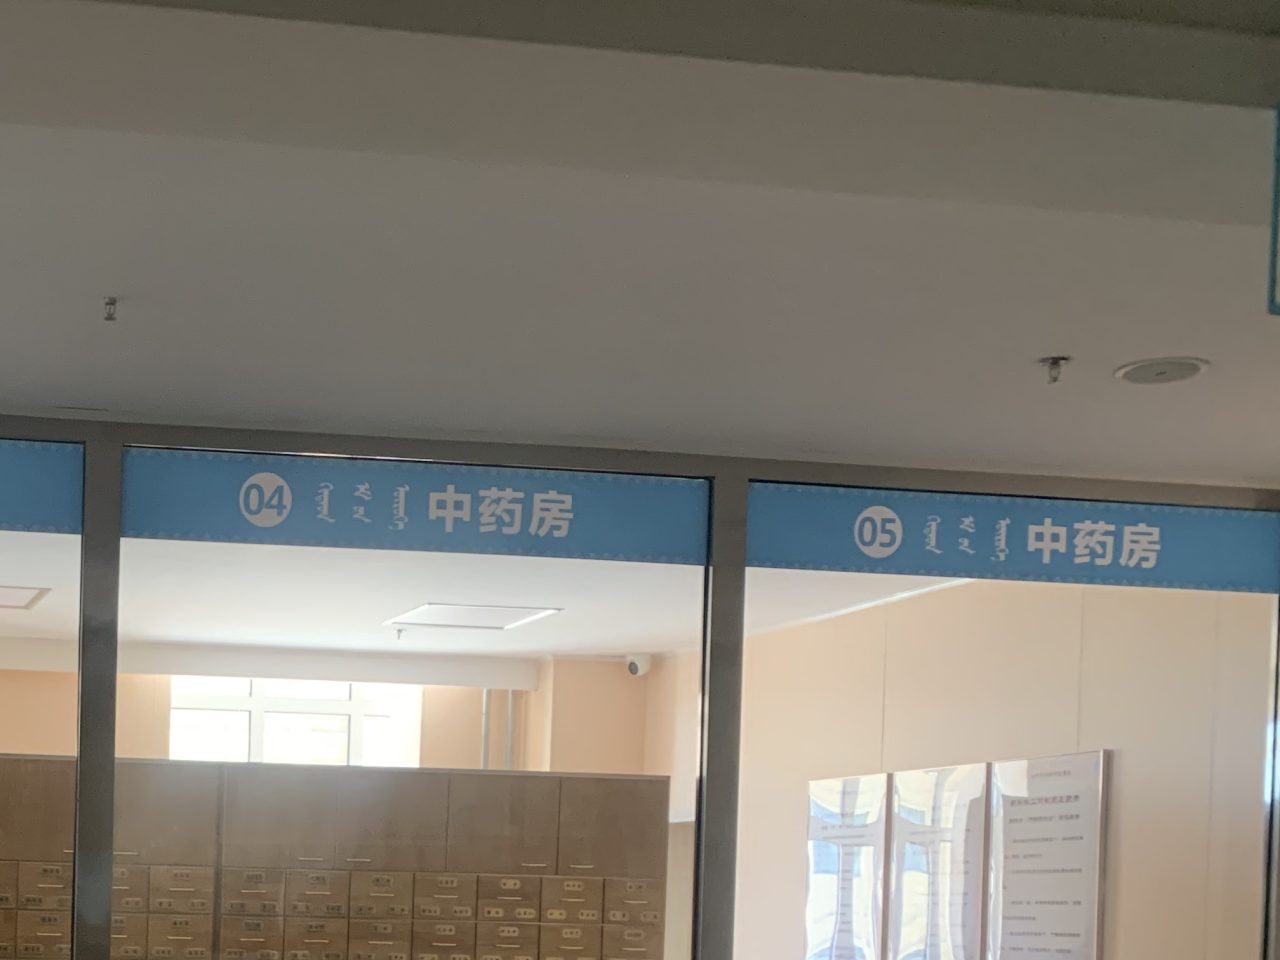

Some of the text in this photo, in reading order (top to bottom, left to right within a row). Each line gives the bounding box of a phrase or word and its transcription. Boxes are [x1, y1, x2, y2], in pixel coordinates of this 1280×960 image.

[244, 483, 287, 516] 04
[428, 484, 574, 538] 中药房
[858, 516, 897, 548] 05
[1027, 517, 1161, 569] 中药房
